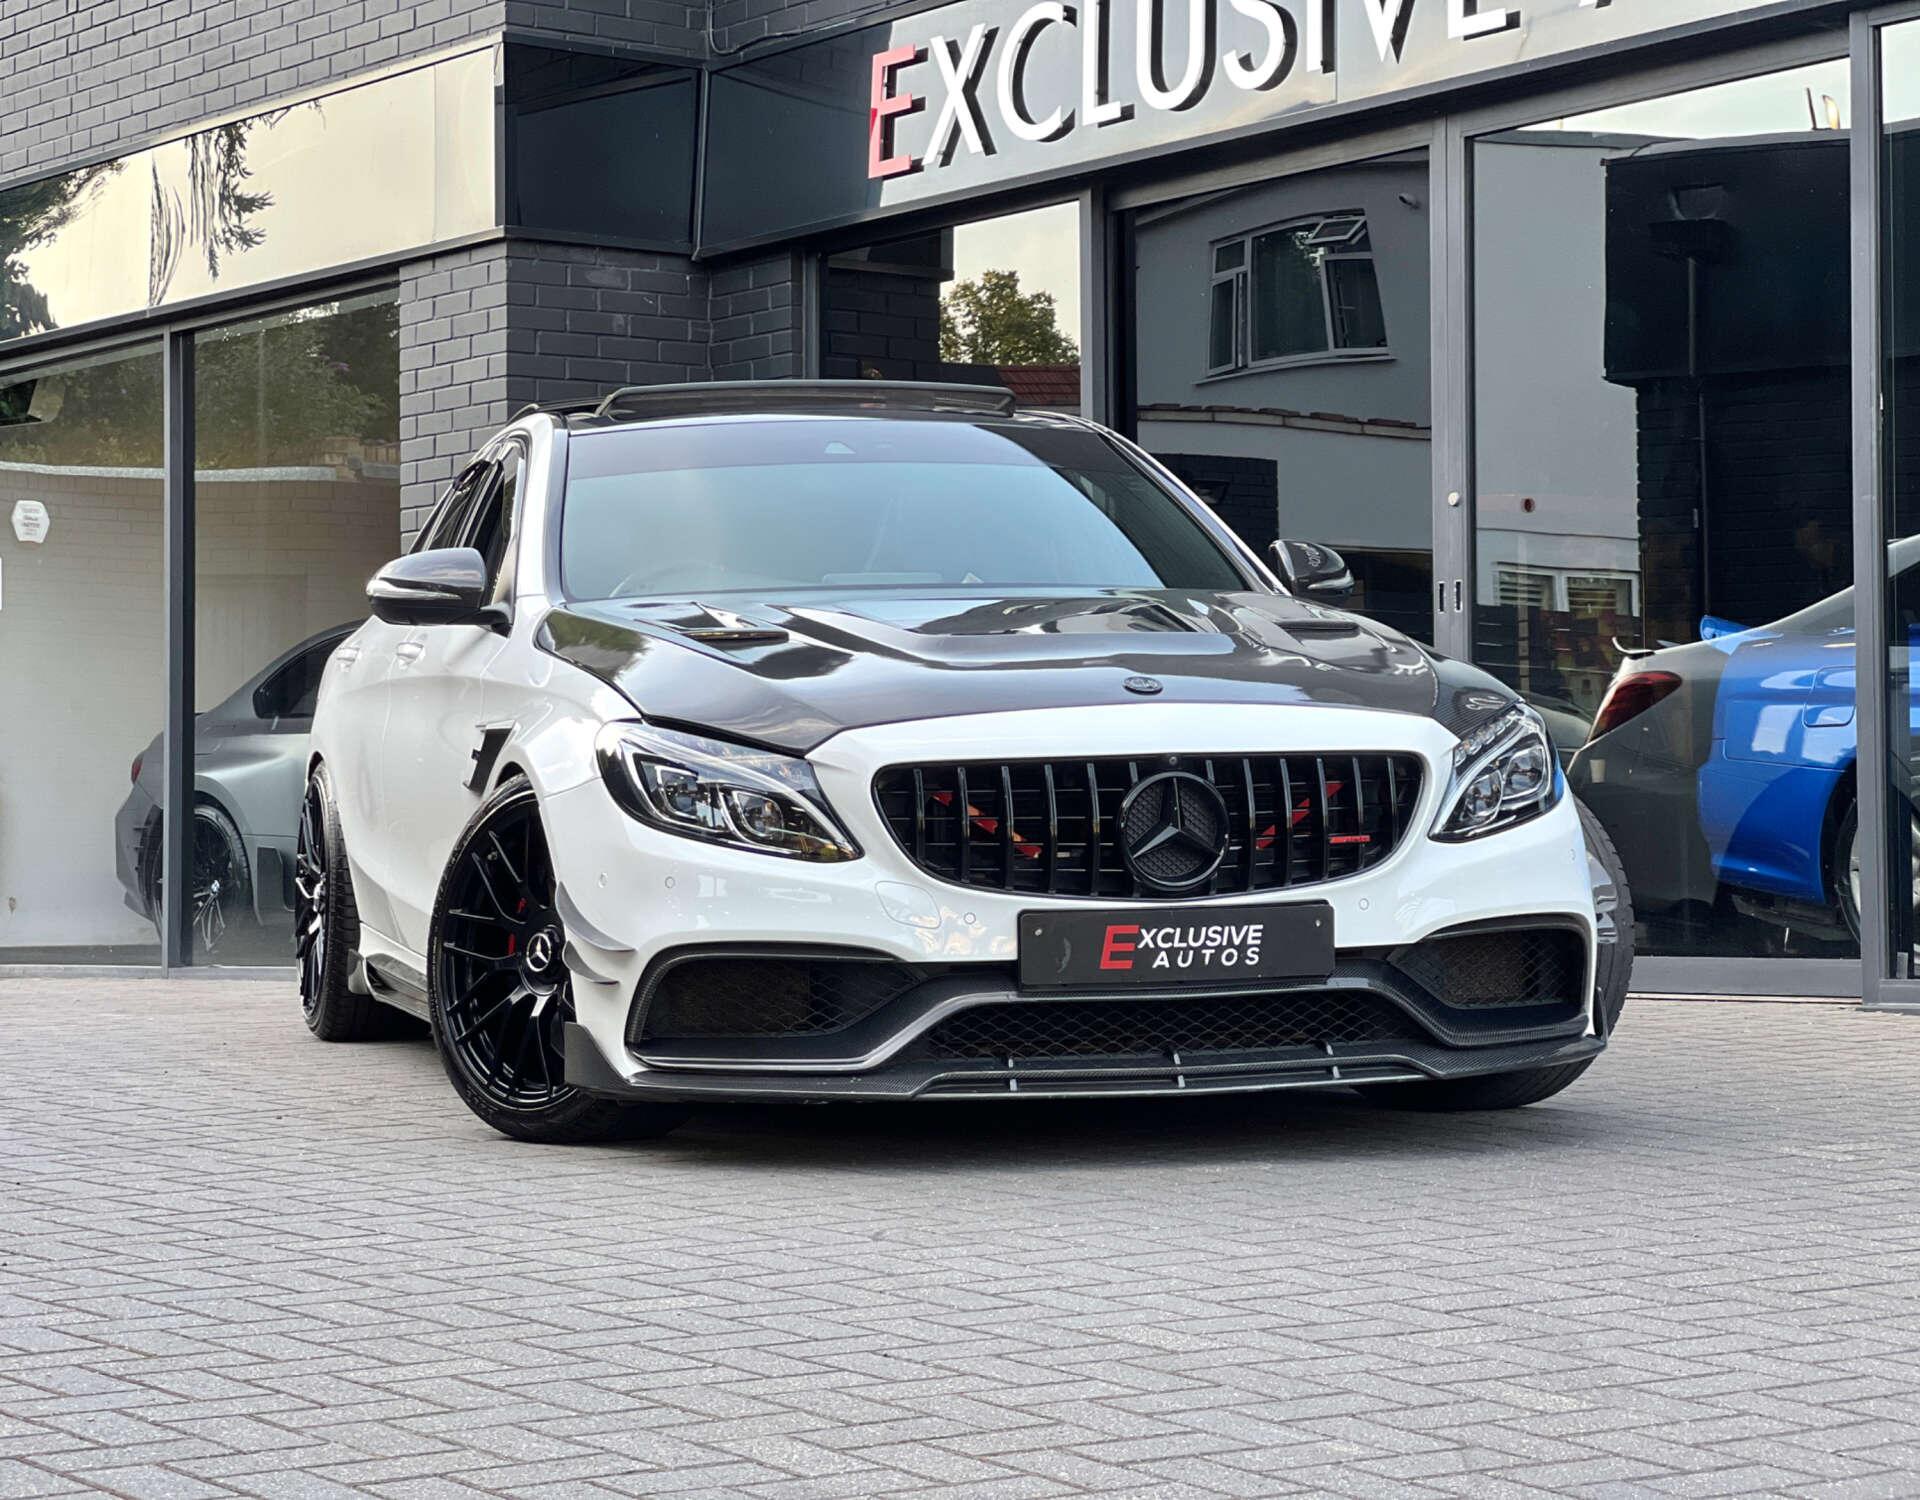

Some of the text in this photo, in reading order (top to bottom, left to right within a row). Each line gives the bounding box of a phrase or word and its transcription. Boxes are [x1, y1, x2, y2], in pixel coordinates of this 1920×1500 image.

[868, 0, 1507, 179] EXCLUS
[1100, 924, 1264, 970] EXCLUSIVE
[1151, 946, 1260, 969] AUTOS
